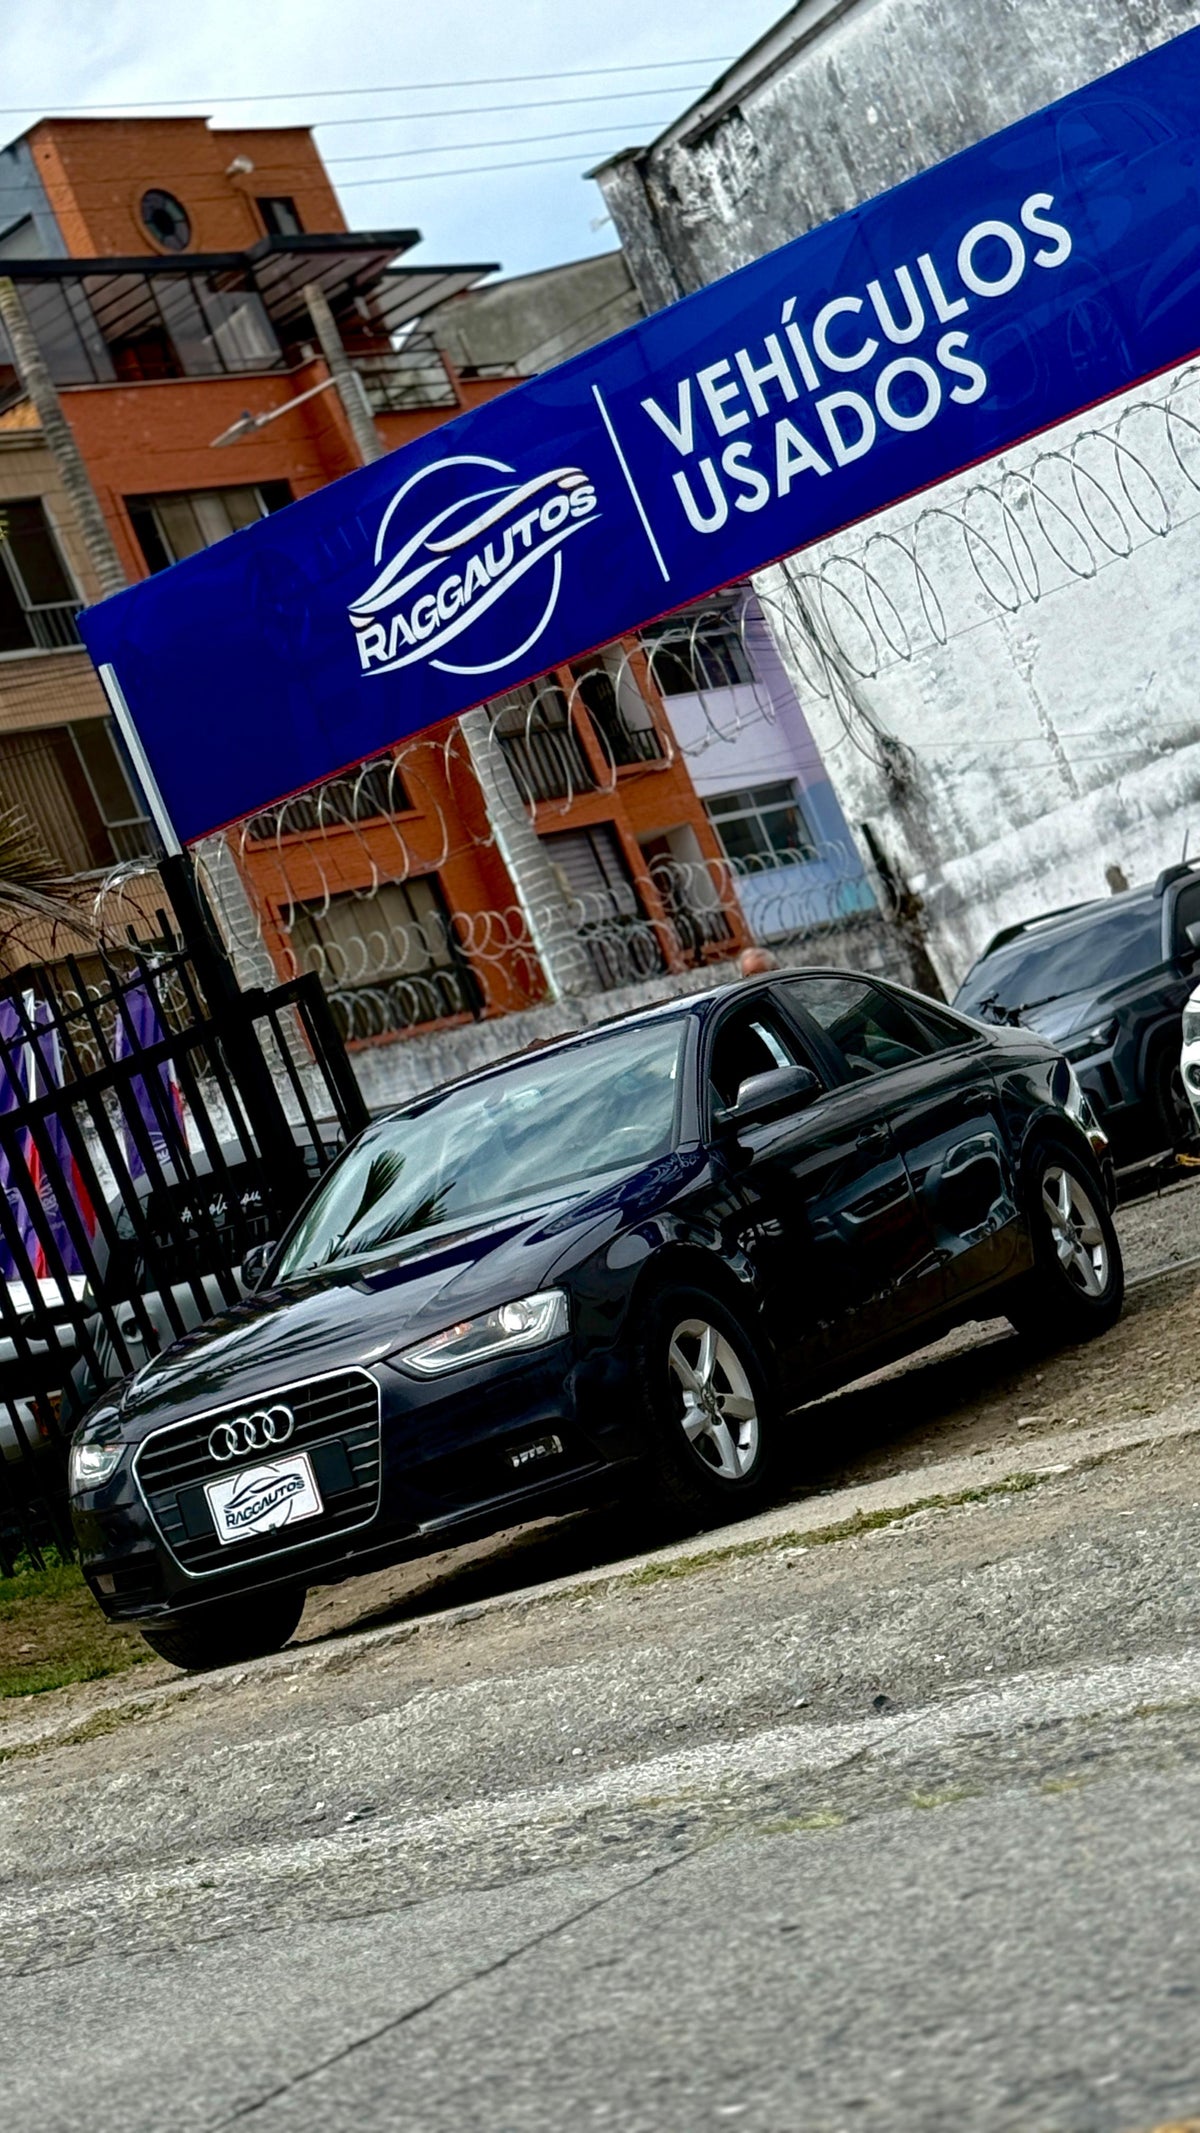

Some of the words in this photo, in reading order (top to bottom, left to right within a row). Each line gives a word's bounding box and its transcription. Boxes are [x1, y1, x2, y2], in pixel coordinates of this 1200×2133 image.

[640, 192, 1073, 456] VEHÍCULOS
[671, 330, 988, 535] USADOS
[355, 485, 597, 669] RAGGAUTOS
[225, 1480, 305, 1527] RAGGAUTOS
